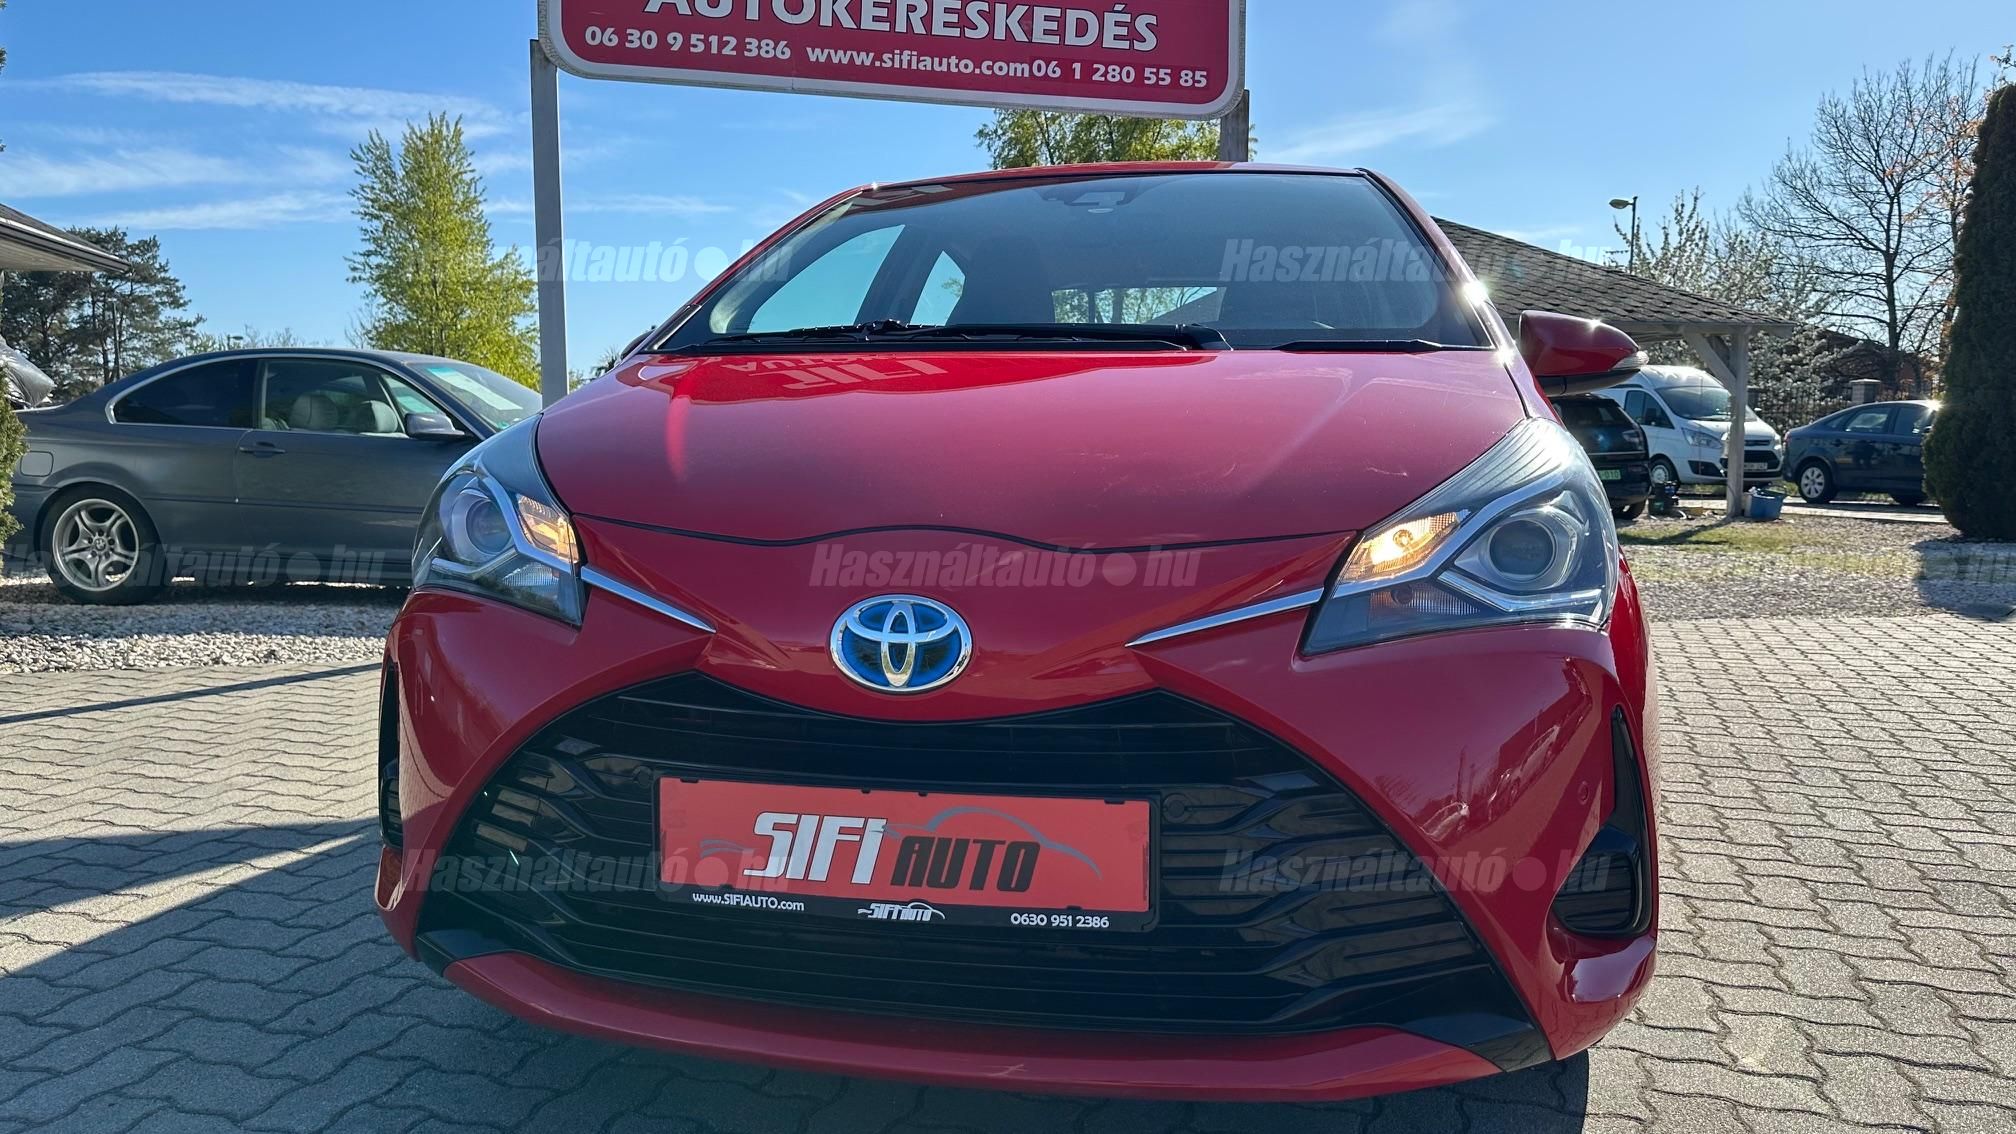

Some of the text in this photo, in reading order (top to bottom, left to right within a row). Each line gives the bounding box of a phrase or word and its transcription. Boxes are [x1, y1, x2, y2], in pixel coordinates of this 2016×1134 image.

[585, 26, 791, 60] 06 30 9 512 386
[1032, 60, 1208, 88] 06 1 280 55 85
[889, 834, 1041, 893] AUTO
[692, 892, 805, 912] www.SIFIAUTO.com
[1010, 913, 1110, 928] 0630 951 2386
